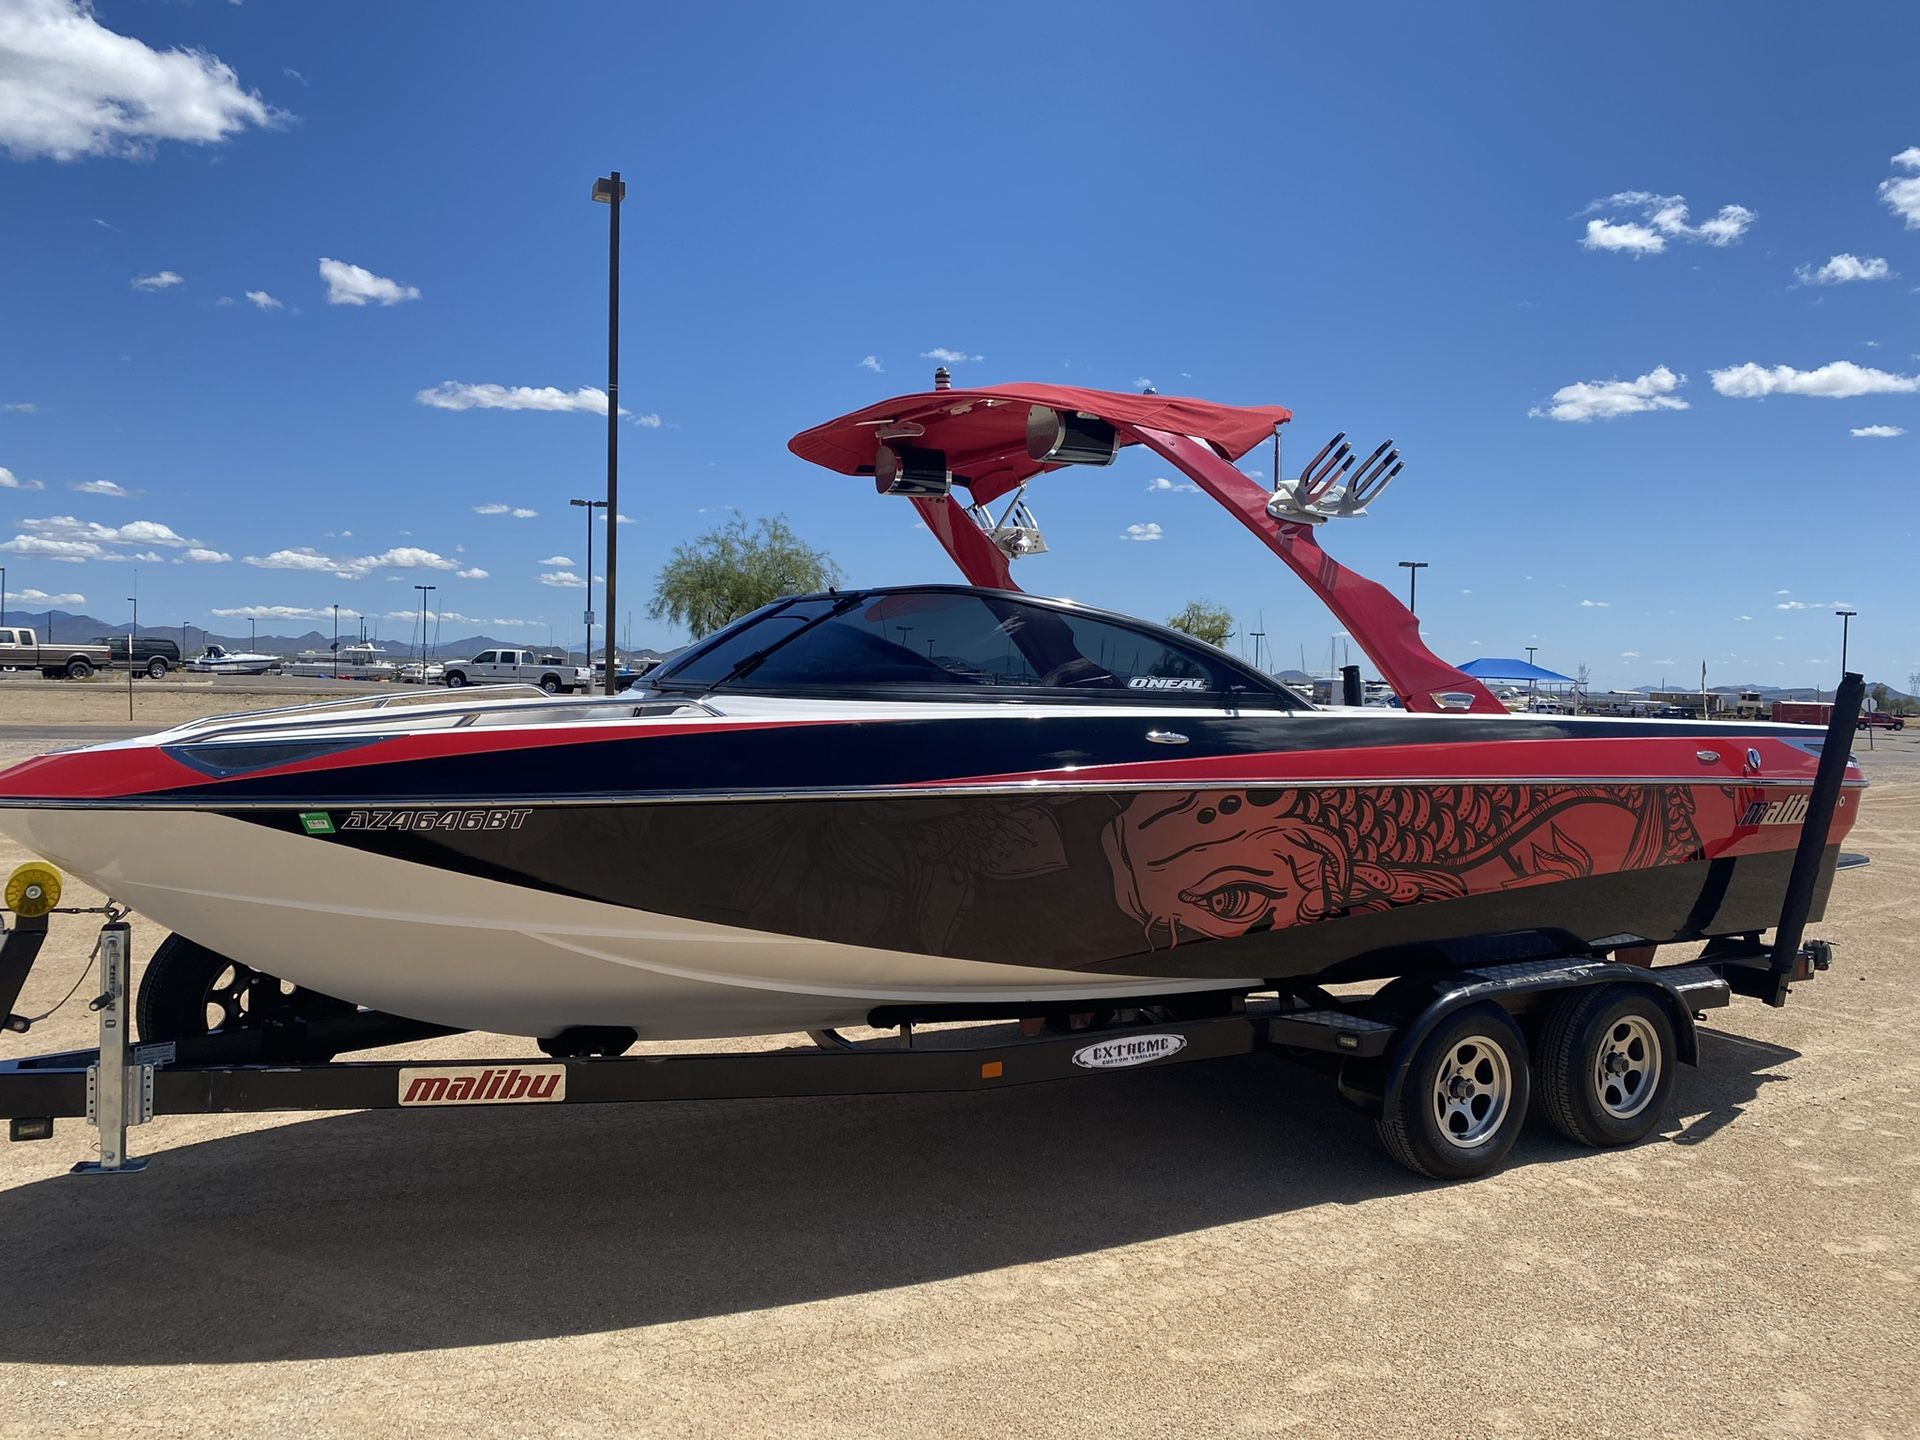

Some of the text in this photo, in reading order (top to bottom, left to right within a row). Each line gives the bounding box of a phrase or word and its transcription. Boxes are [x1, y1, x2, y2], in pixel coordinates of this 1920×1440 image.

[1128, 676, 1206, 691] O'NEAL
[340, 808, 533, 831] AZ4646BT
[1738, 794, 1809, 826] malib
[1093, 1038, 1169, 1060] EXTREME
[1102, 1053, 1160, 1065] CUSTOM TRAILERS
[403, 1069, 562, 1102] malibu
